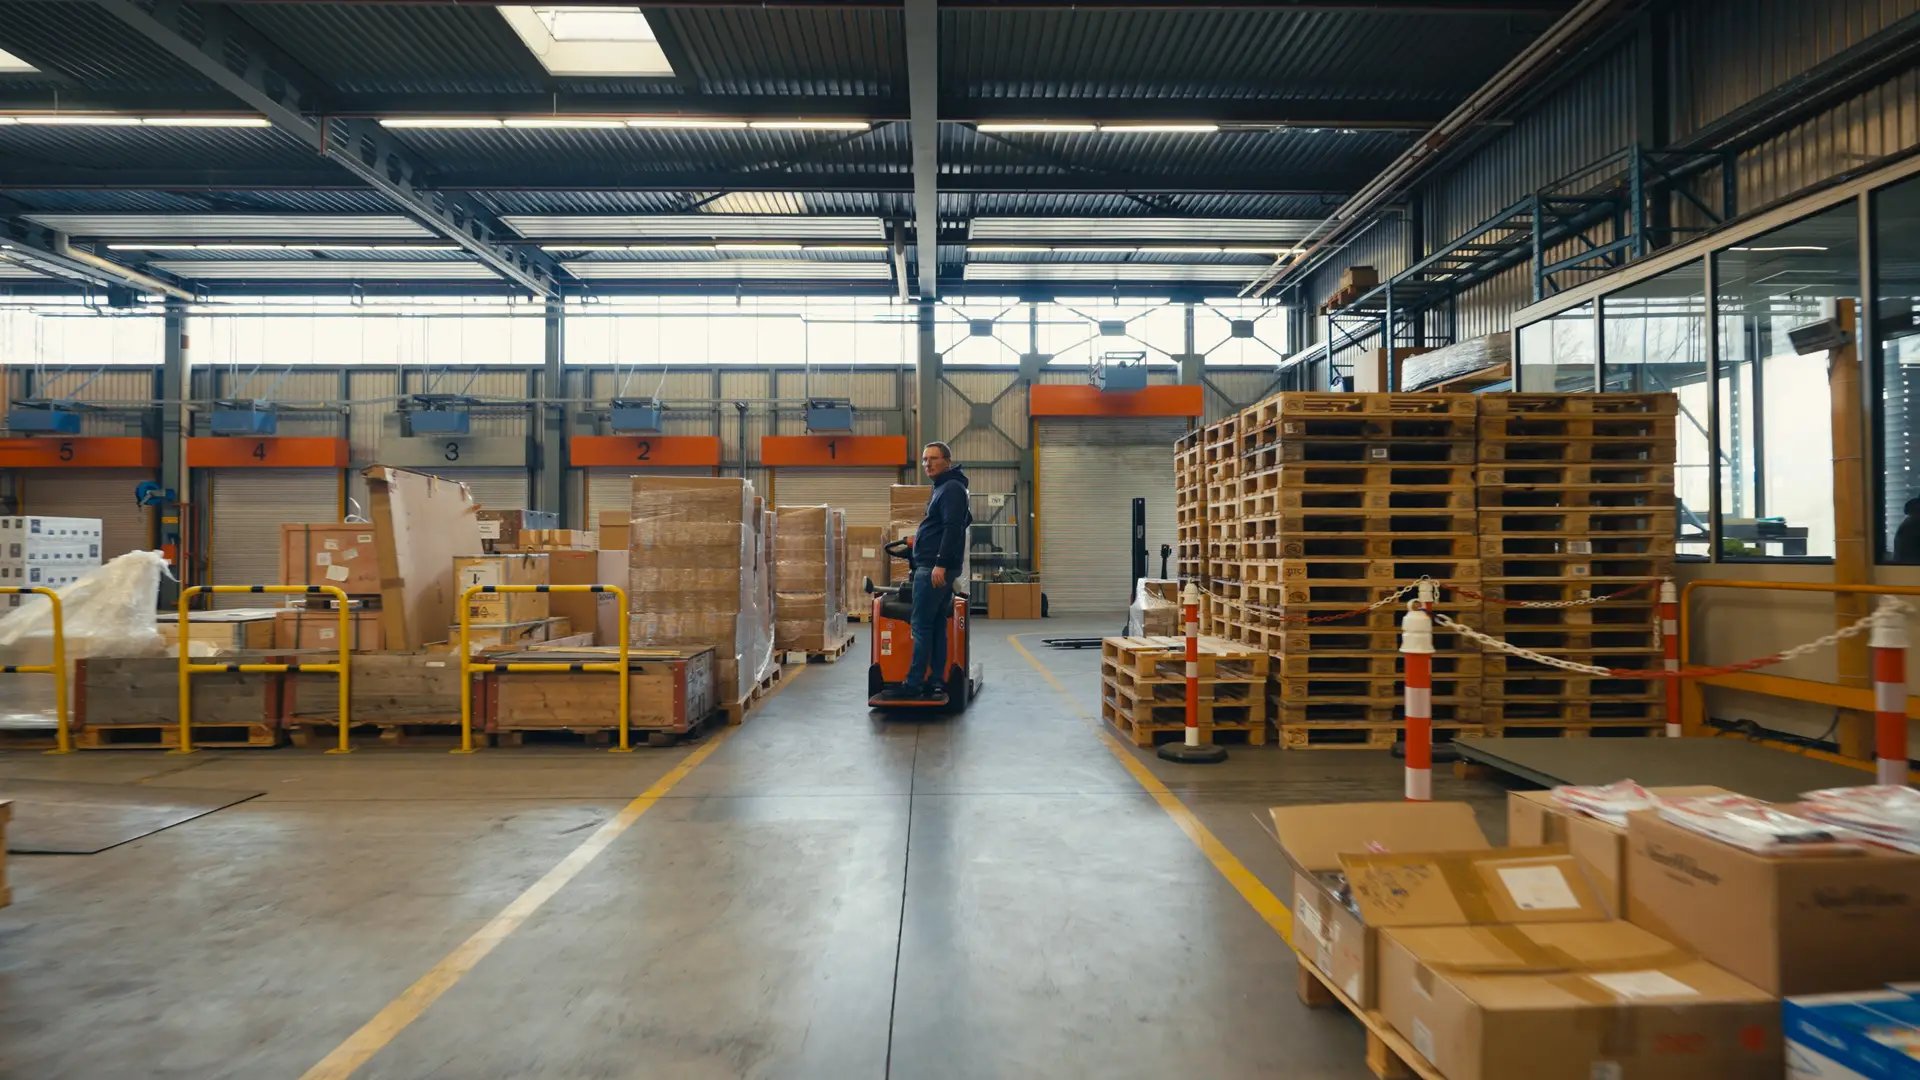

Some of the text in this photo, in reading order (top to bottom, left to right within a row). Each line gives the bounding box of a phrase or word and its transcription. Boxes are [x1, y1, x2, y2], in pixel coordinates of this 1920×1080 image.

[60, 442, 73, 461] 5
[253, 443, 266, 461] 4
[445, 442, 459, 461] 3
[637, 441, 650, 460] 2
[828, 440, 836, 459] 1
